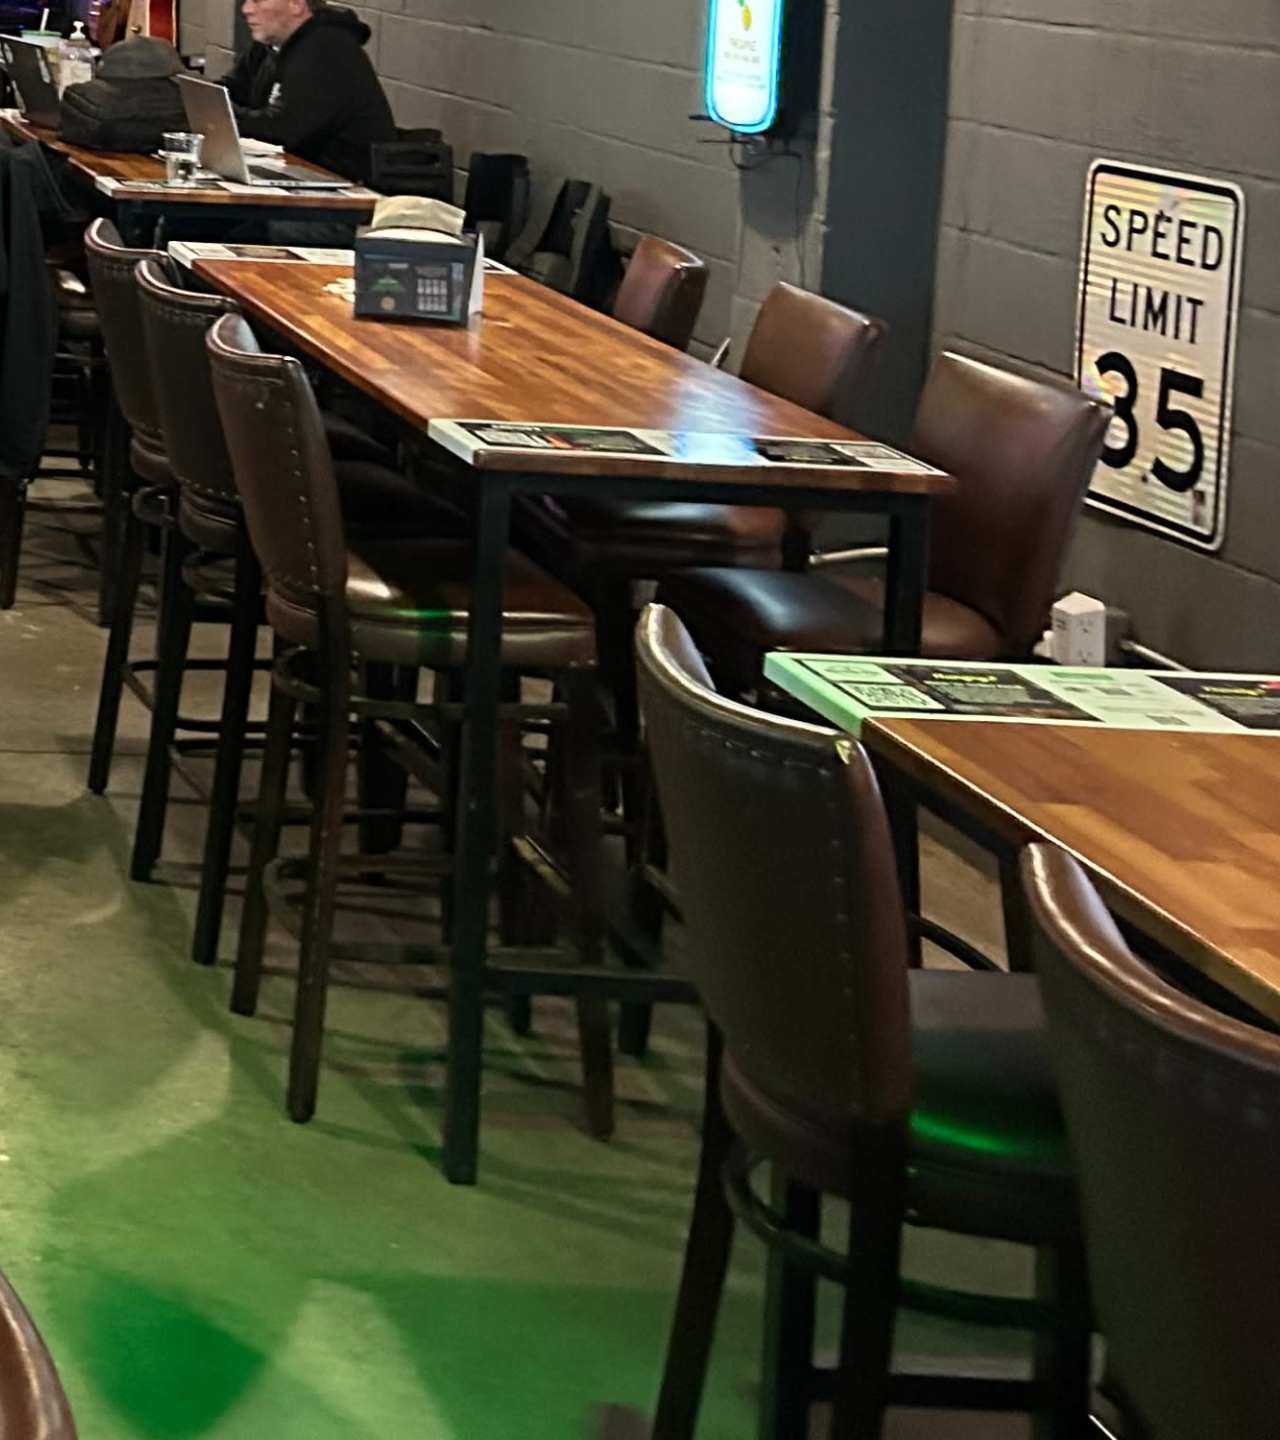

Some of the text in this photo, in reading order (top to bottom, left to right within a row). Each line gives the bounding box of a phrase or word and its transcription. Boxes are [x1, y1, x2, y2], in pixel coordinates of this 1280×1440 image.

[1100, 203, 1224, 271] SPEED
[1108, 277, 1204, 344] LIMIT
[1093, 351, 1204, 492] 35
